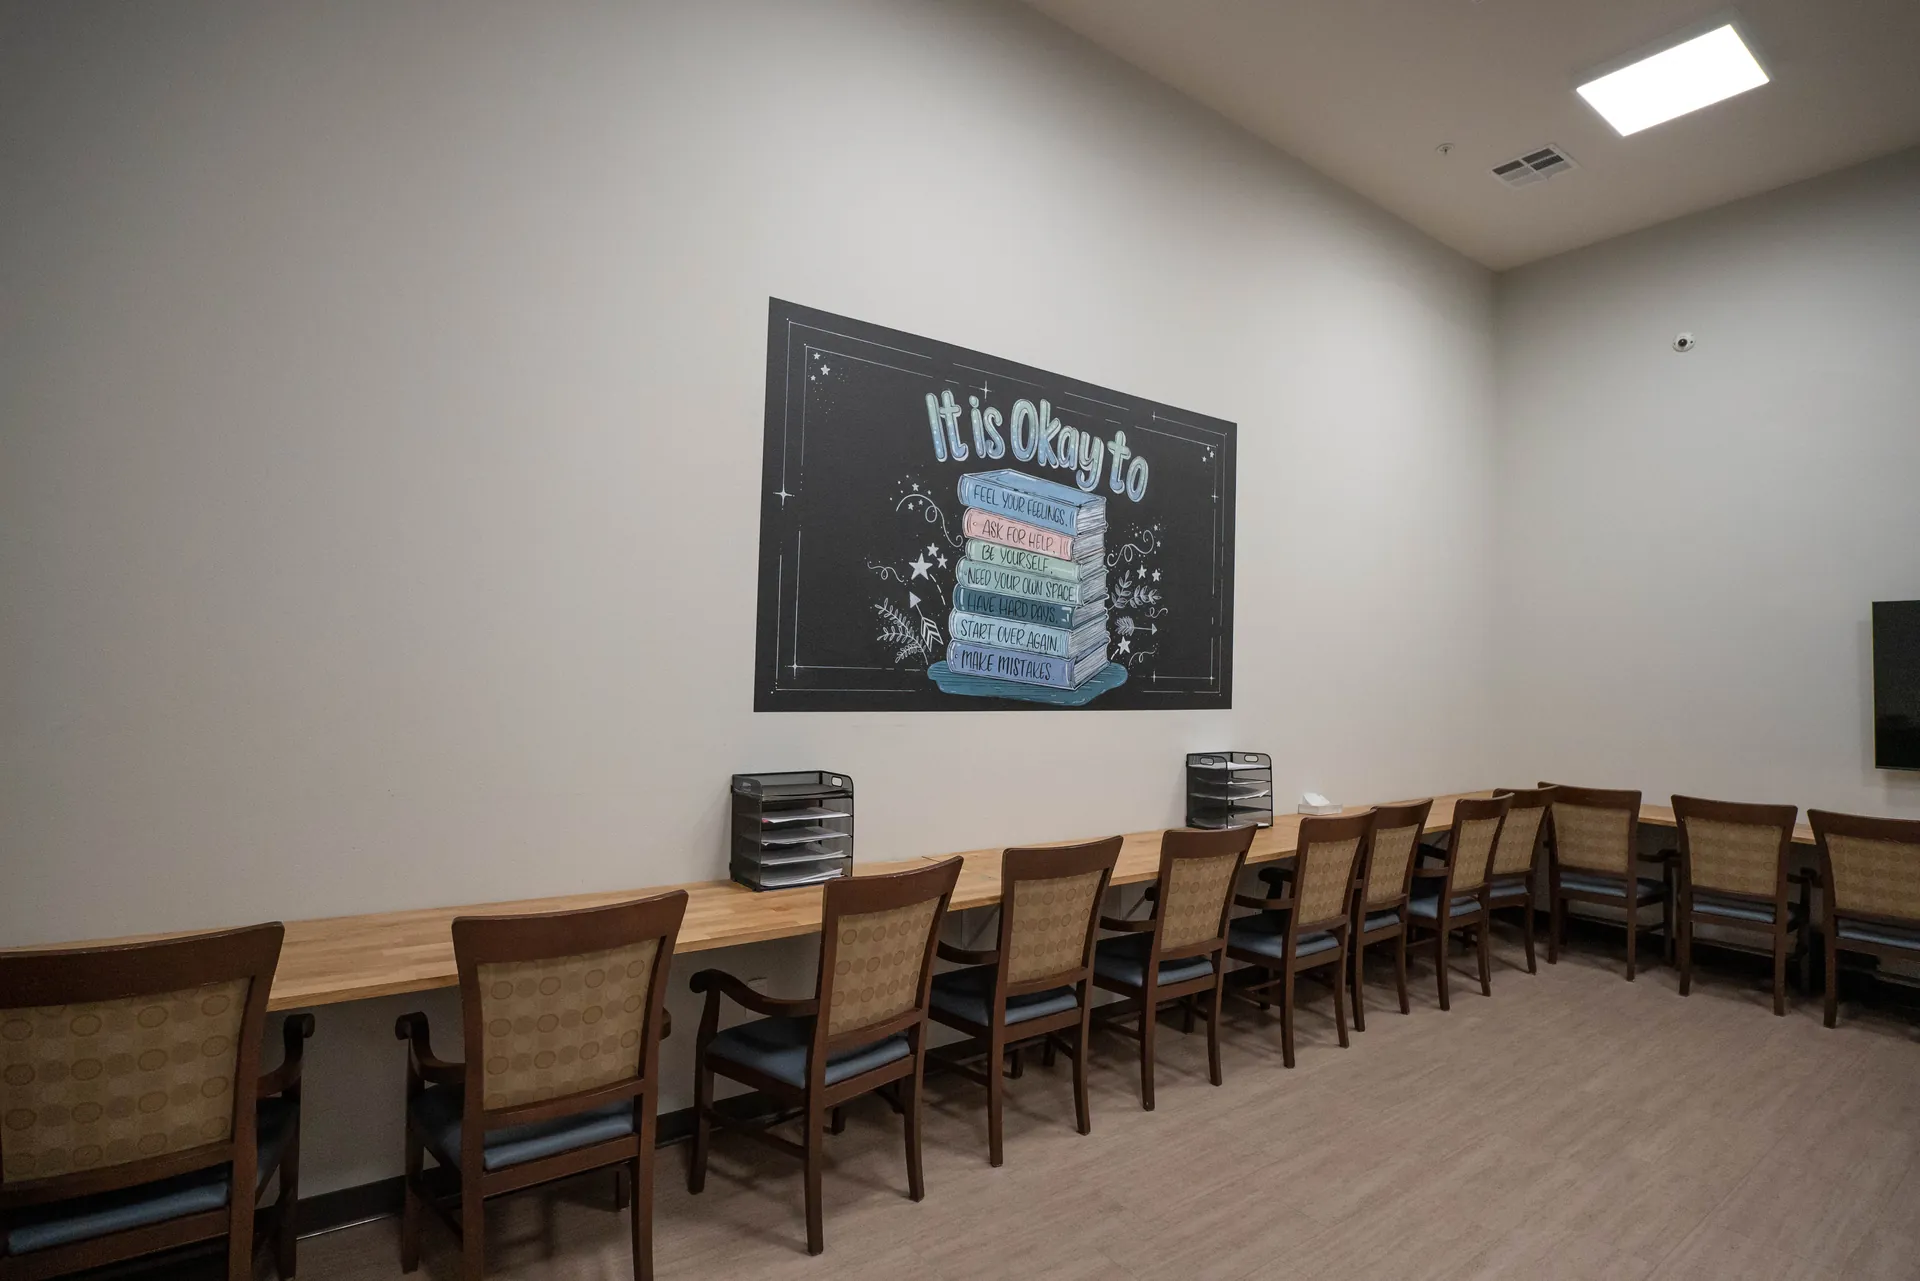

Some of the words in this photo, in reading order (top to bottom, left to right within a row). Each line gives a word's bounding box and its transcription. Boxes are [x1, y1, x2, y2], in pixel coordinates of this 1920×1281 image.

[925, 390, 969, 462] It
[969, 395, 1005, 459] is
[1011, 399, 1104, 492] Okay
[1107, 430, 1149, 502] to
[974, 484, 999, 506] FEEL
[1002, 492, 1024, 513] YOUR
[1027, 501, 1068, 527] FEELINGS.
[982, 519, 1003, 540] ASK
[1007, 526, 1026, 546] FOR
[1029, 533, 1056, 554] HELP.
[981, 545, 995, 561] BE
[1001, 549, 1053, 574] YOURSELF.
[967, 567, 991, 585] NEED
[994, 571, 1020, 593] YOUR
[1022, 578, 1043, 596] OWN
[967, 593, 995, 612] HAVE
[999, 599, 1027, 619] HARD
[1030, 604, 1058, 624] DAYS.
[960, 619, 995, 640] START
[997, 626, 1025, 646] OVER
[1026, 631, 1059, 653] AGAIN.
[961, 650, 997, 672] MAKE
[998, 656, 1055, 681] MISTAKES.
